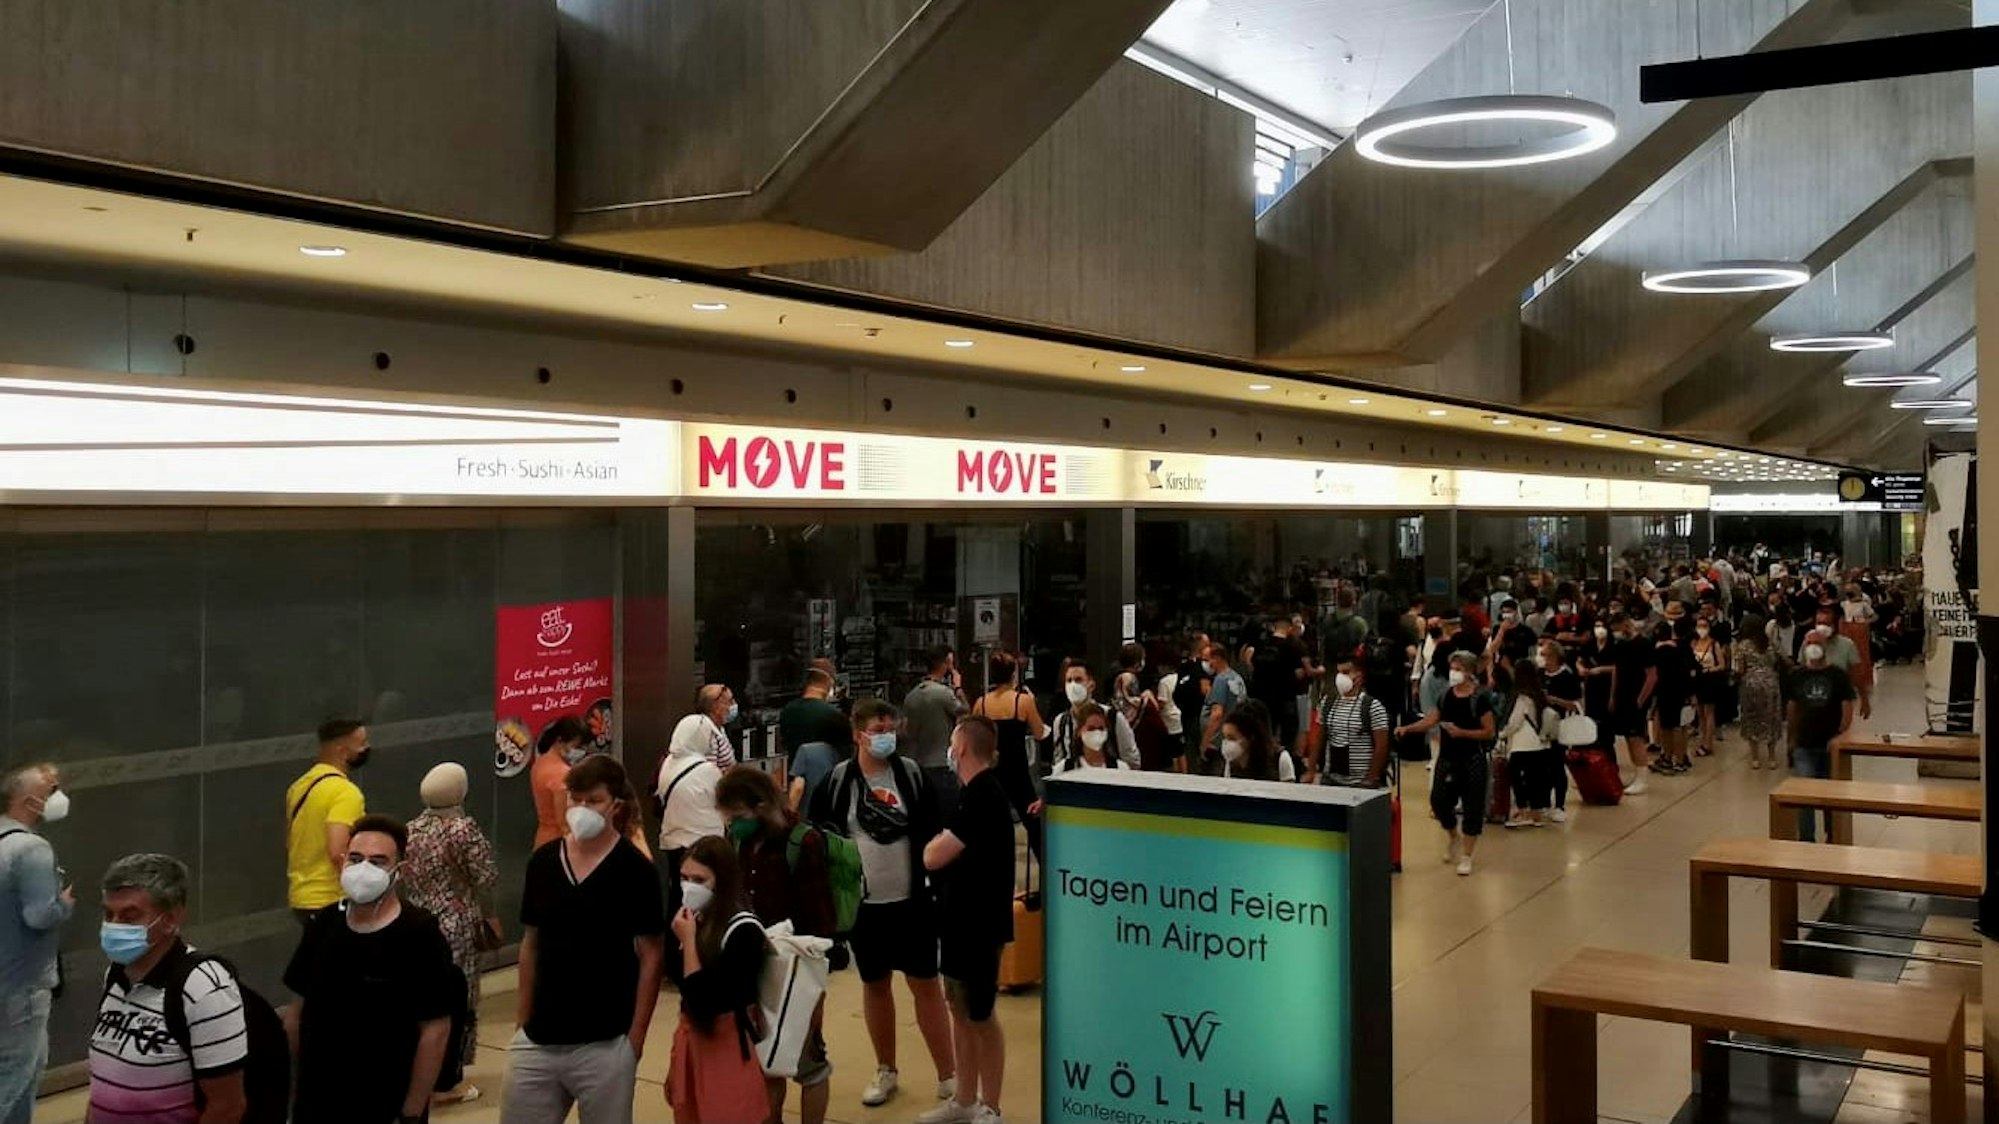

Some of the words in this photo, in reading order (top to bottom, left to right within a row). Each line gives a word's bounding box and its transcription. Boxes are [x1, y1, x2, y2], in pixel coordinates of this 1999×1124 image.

[699, 435, 845, 490] MOVE
[957, 449, 1057, 494] MOVE
[1058, 868, 1147, 906] Tagen
[1159, 885, 1218, 914] und
[1231, 887, 1329, 927] Feiern
[1117, 915, 1150, 947] im
[1162, 922, 1269, 962] Airport
